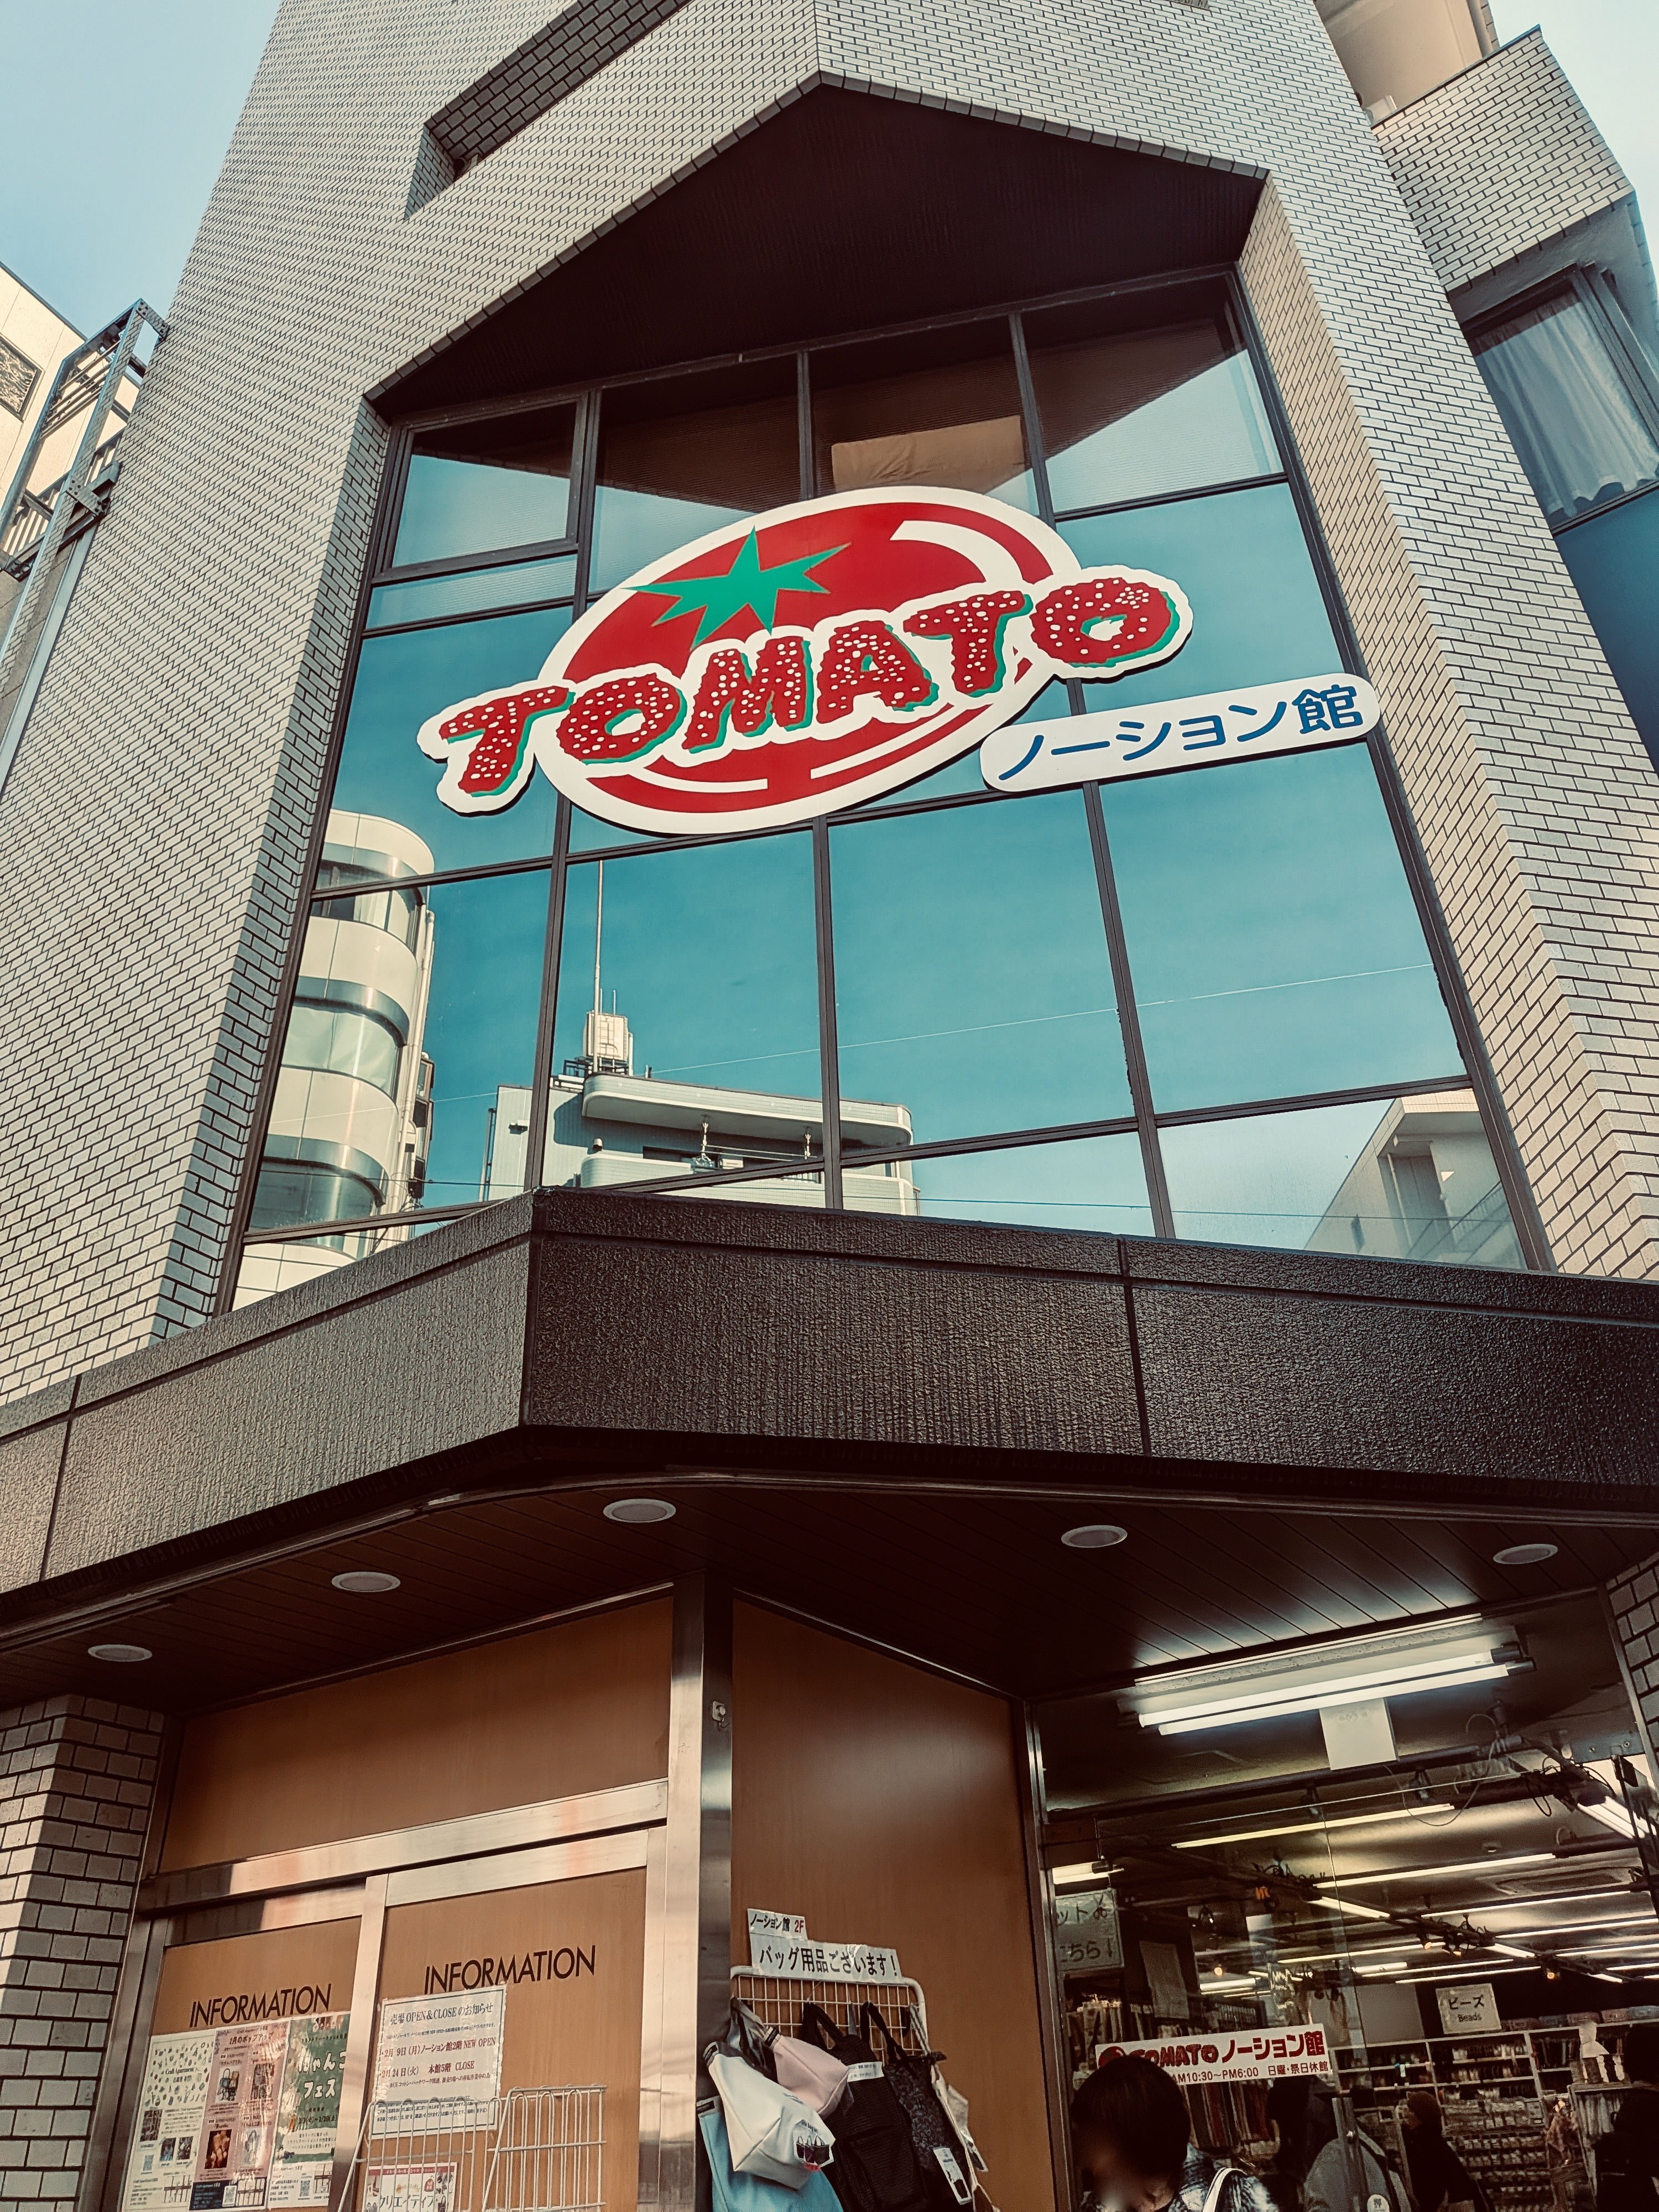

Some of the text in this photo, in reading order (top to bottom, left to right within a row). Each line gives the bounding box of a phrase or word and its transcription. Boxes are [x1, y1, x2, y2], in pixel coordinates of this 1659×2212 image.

[439, 574, 1181, 797] TOMATO
[998, 684, 1364, 781] ノーション館
[794, 1919, 804, 1933] 2F
[424, 1945, 596, 1995] INFORMATION
[190, 1983, 332, 2028] INFORMATION
[390, 2002, 494, 2025] 売場 OPEN&CLOSE のお知らせ
[463, 2038, 476, 2048] NEW
[478, 2037, 497, 2047] OPEN
[1222, 2031, 1326, 2063] ノーション館
[455, 2060, 474, 2071] CLOSE
[1268, 2061, 1328, 2077] 日曜・祭日休館
[304, 2078, 336, 2099] フェス
